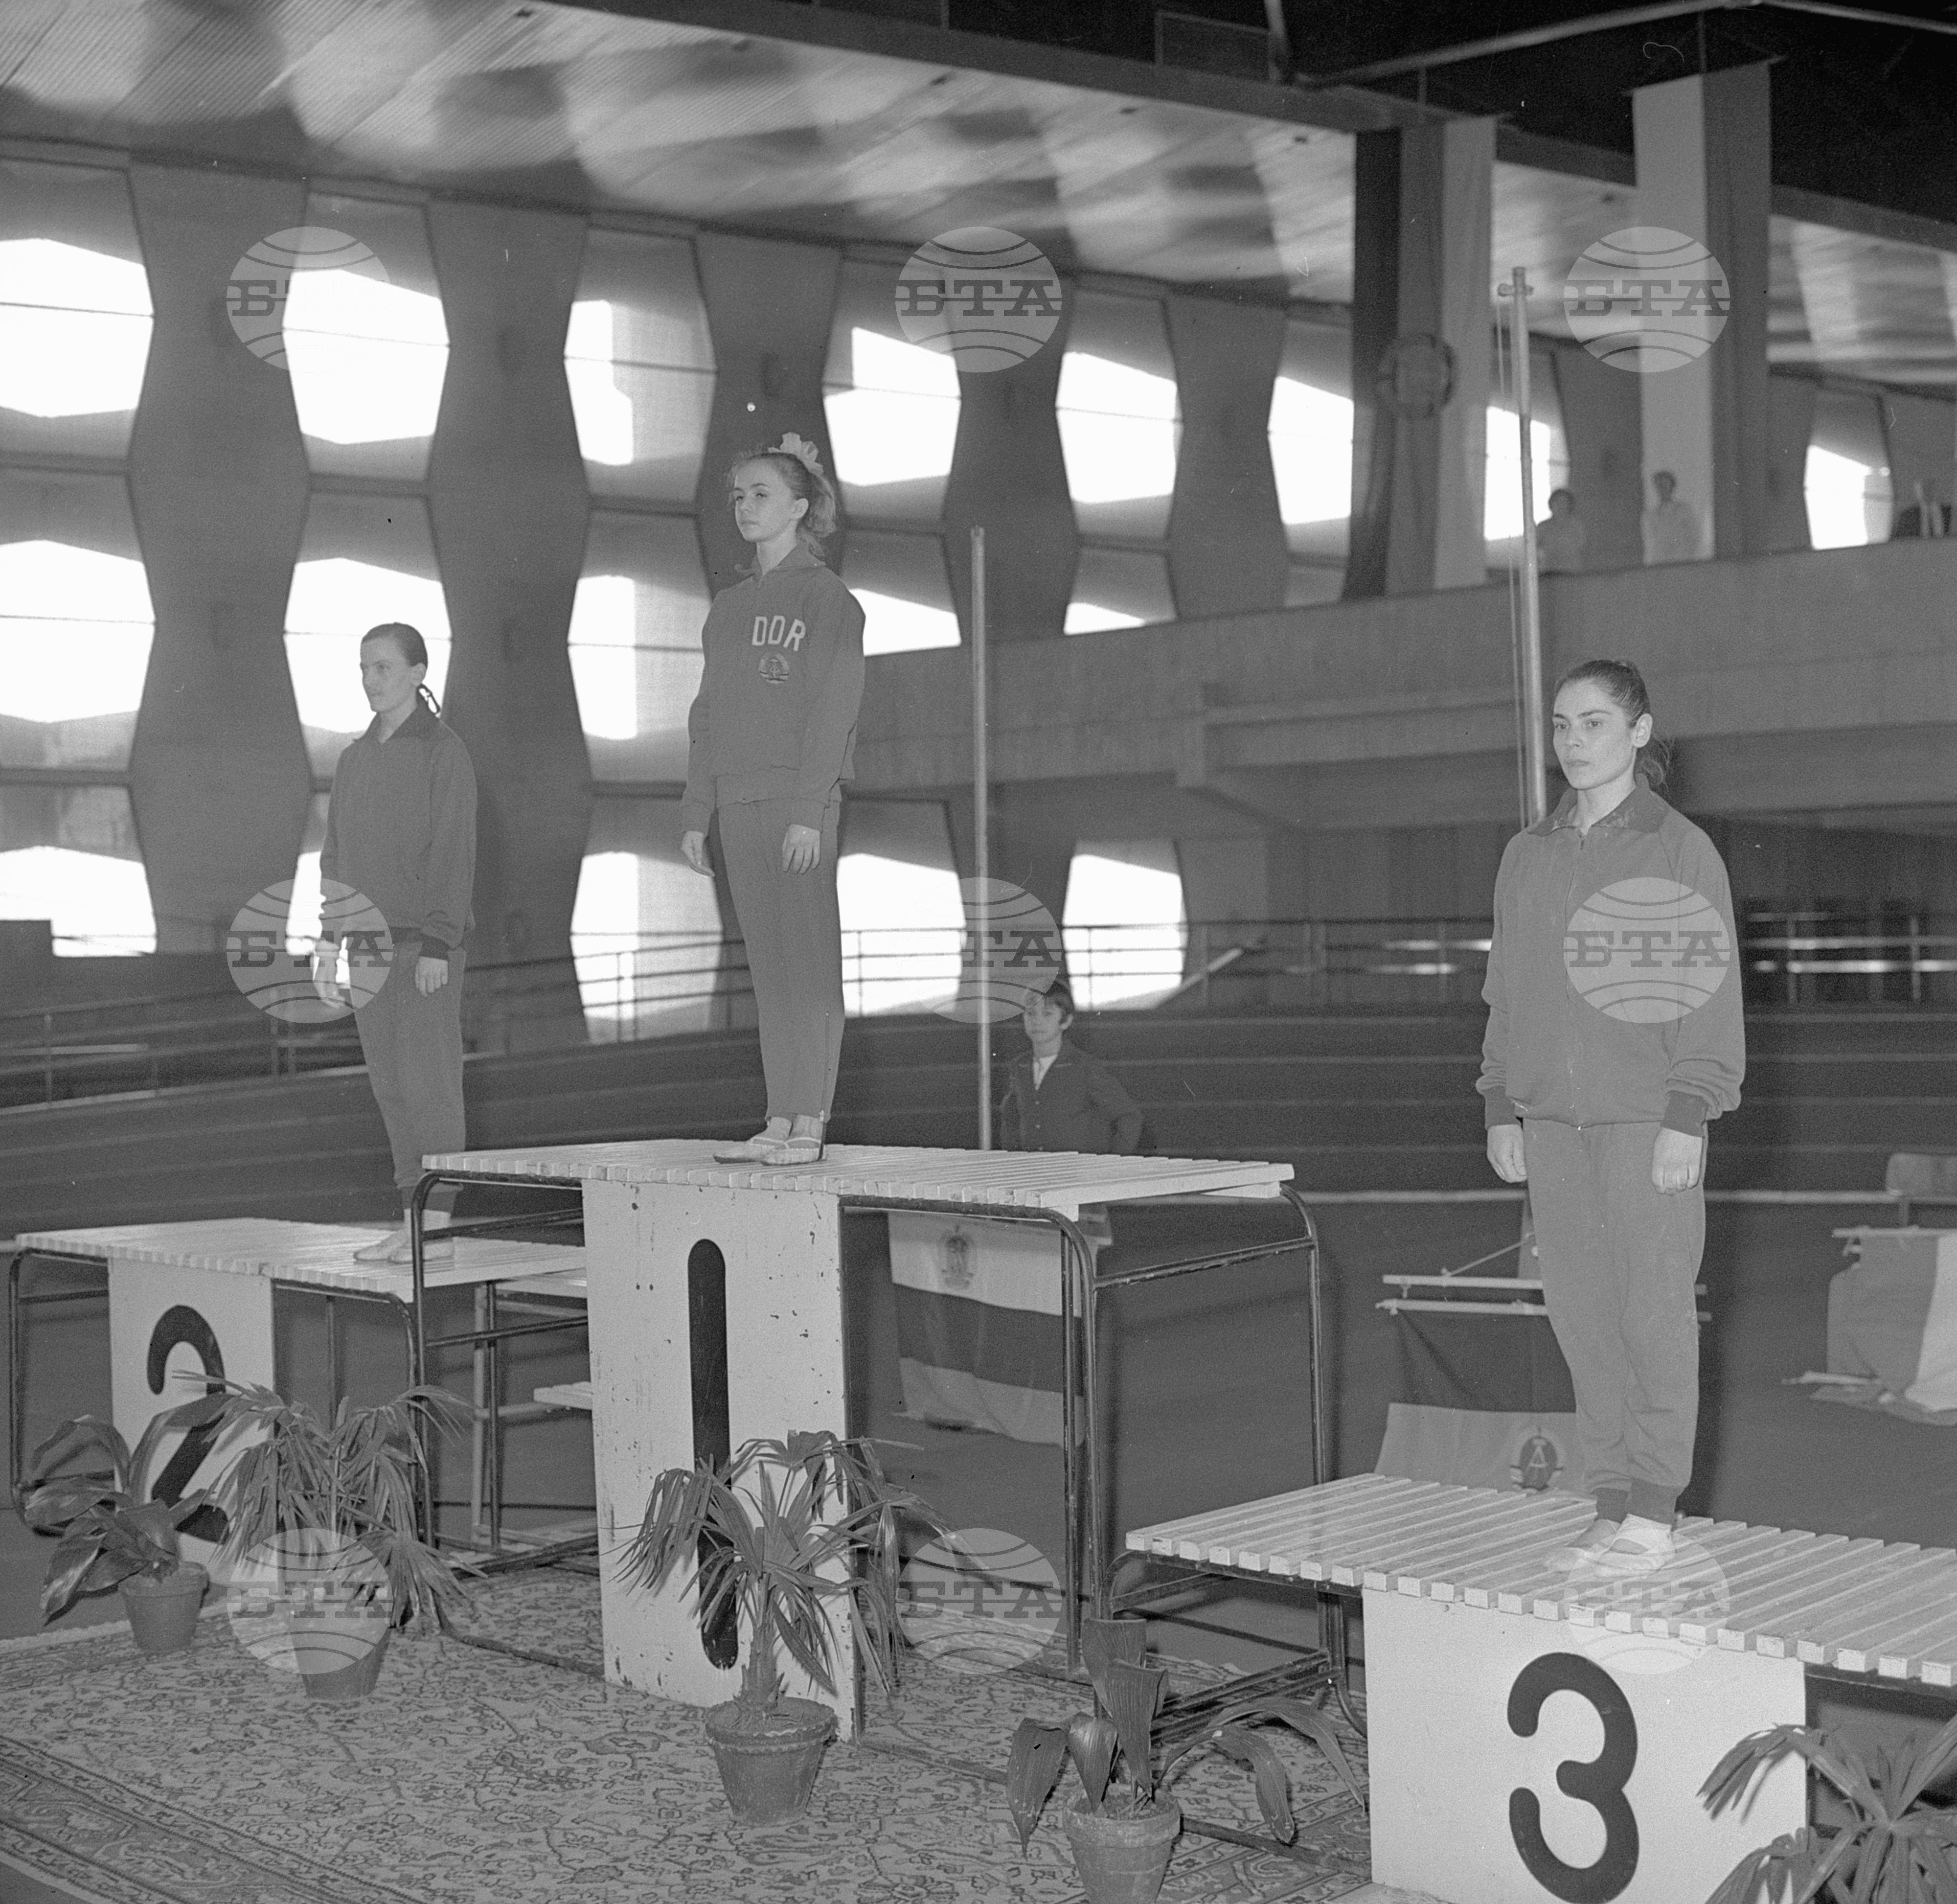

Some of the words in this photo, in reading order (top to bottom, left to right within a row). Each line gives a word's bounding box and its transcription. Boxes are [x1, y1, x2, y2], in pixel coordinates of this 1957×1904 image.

[752, 616, 806, 651] DDR
[147, 1305, 231, 1545] 2
[1507, 1652, 1639, 1904] 3
